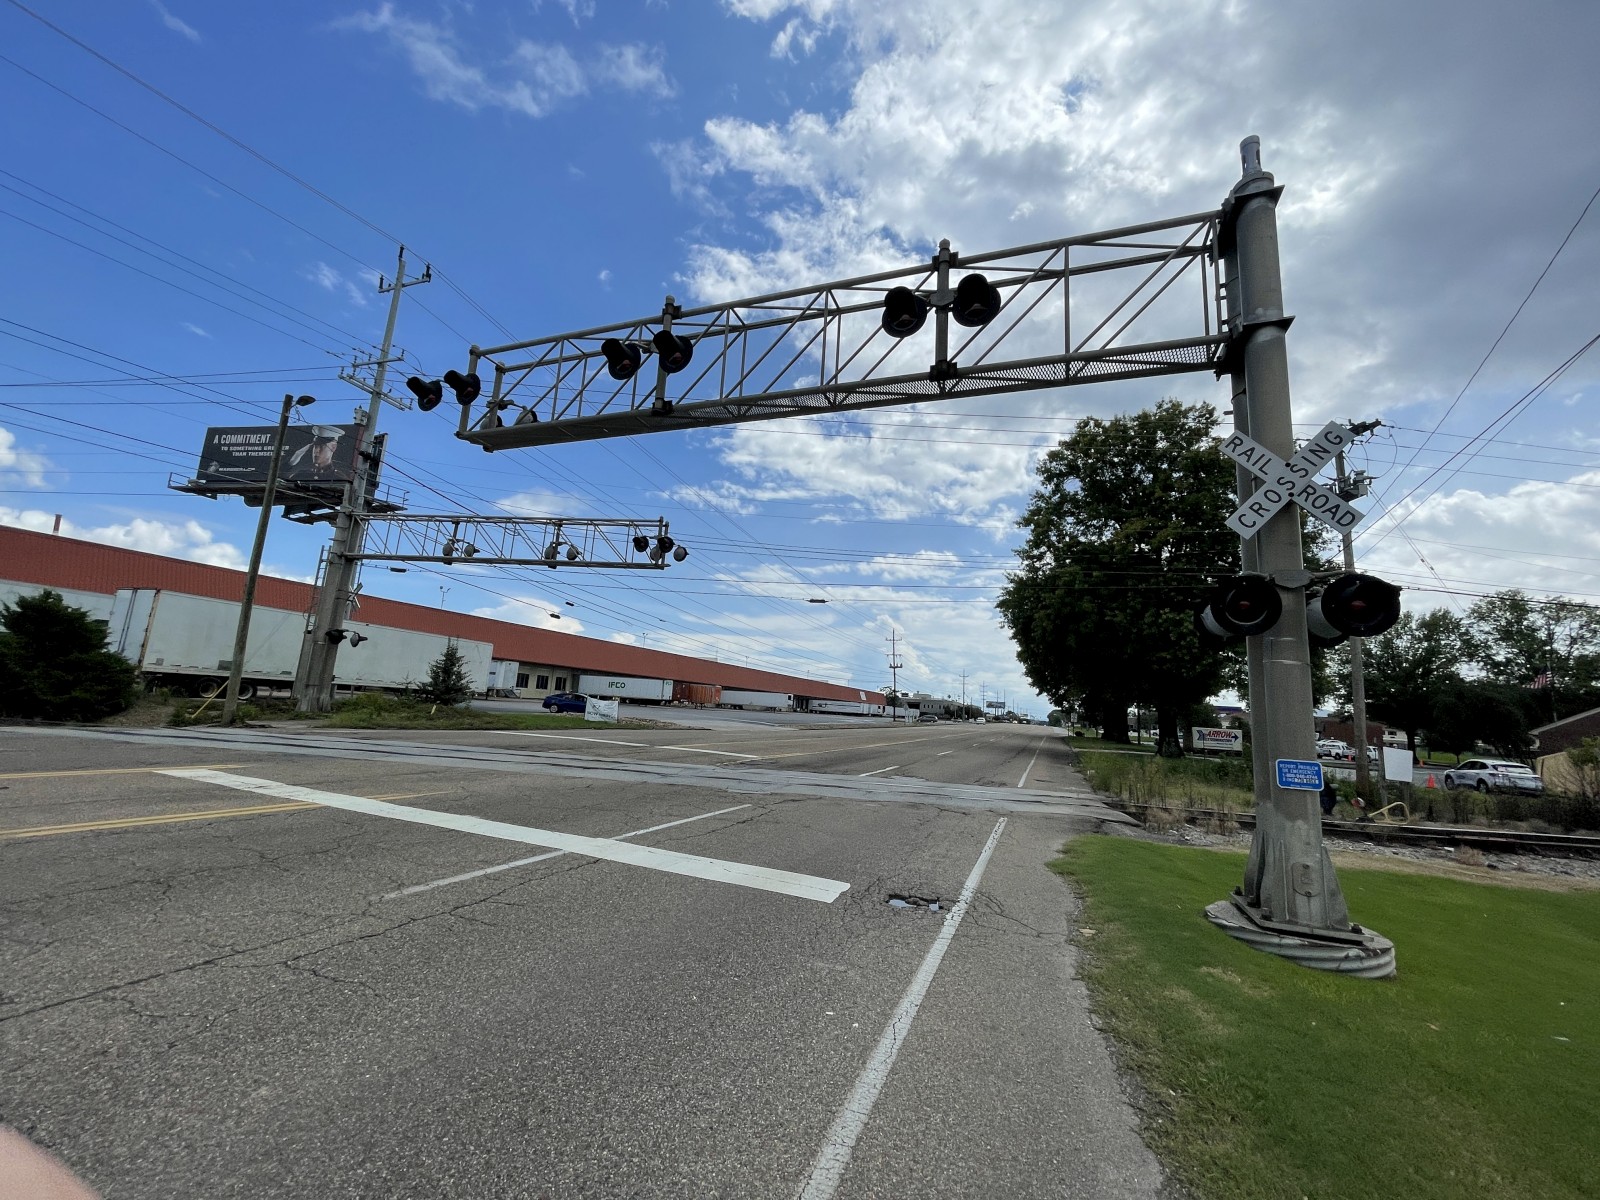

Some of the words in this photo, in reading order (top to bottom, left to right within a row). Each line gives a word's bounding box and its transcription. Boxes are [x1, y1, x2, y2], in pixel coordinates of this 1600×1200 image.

[213, 434, 219, 444] A
[220, 434, 271, 444] COMMITMENT
[1225, 435, 1272, 476] RAIL
[1297, 484, 1356, 527] ROAD
[1238, 430, 1344, 529] CROSSING
[608, 681, 626, 689] IFCO
[1207, 730, 1233, 738] ARROW
